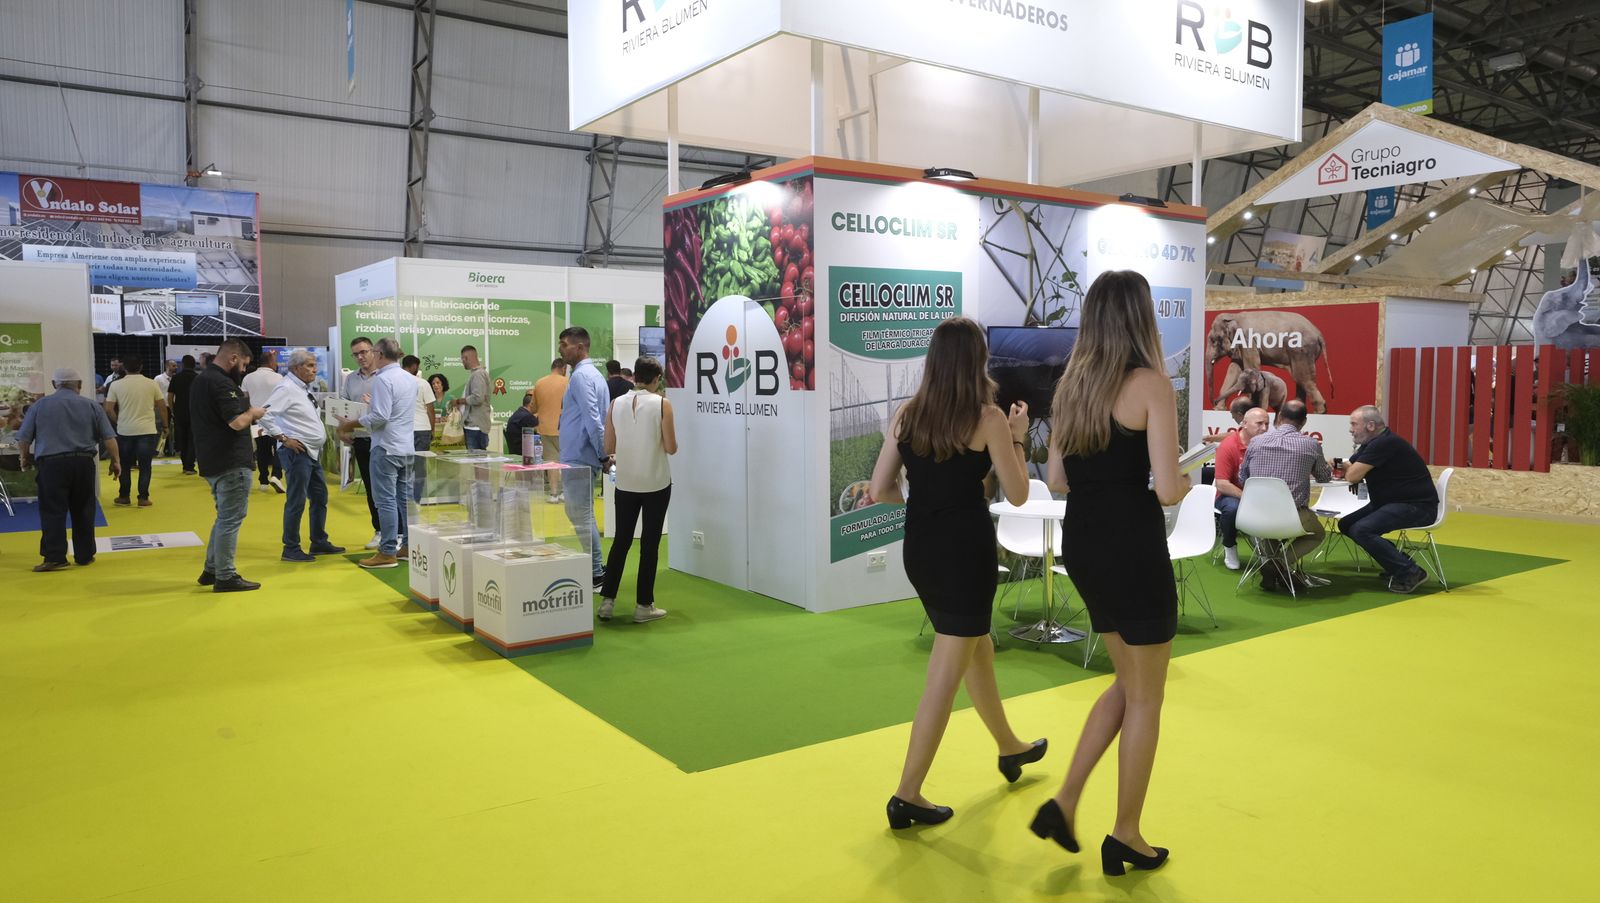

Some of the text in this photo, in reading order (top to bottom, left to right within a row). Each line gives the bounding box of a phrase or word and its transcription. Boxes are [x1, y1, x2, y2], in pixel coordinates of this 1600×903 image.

[622, 0, 708, 56] RIVIERA BLUMEN
[1174, 52, 1270, 91] RIVIERA BLUMEN
[1387, 65, 1428, 82] cajamar
[1351, 145, 1401, 164] Grupo
[1351, 158, 1437, 181] Tecniagro
[98, 201, 140, 215] Solar
[831, 211, 958, 241] CELLOCLIM SR
[97, 231, 156, 246] industrial
[170, 236, 233, 251] agricultura
[37, 249, 187, 266] Empresa Almeriense con amplia experiencia
[1181, 245, 1196, 263] 7K
[468, 271, 505, 284] Bioera
[838, 281, 955, 309] CELLOCLIM SR
[488, 302, 500, 311] de
[1173, 299, 1186, 318] 7K
[421, 312, 463, 323] basados
[464, 315, 476, 323] en
[840, 310, 880, 322] DIFUSIÓN
[882, 311, 917, 321] NATURAL
[919, 311, 929, 320] DE
[930, 311, 940, 320] LA
[427, 326, 433, 337] y
[862, 330, 879, 341] FILM
[881, 328, 911, 339] TÉRMICO
[1231, 328, 1303, 349] Ahora
[865, 341, 876, 351] DE
[877, 340, 901, 350] LARGA
[696, 401, 778, 417] RIVIERA BLUMEN
[841, 514, 889, 537] FORMULADO
[888, 512, 896, 522] A
[860, 531, 878, 542] PARA
[878, 525, 895, 536] TODO
[477, 591, 503, 613] motrifil
[522, 588, 584, 613] motrifil
